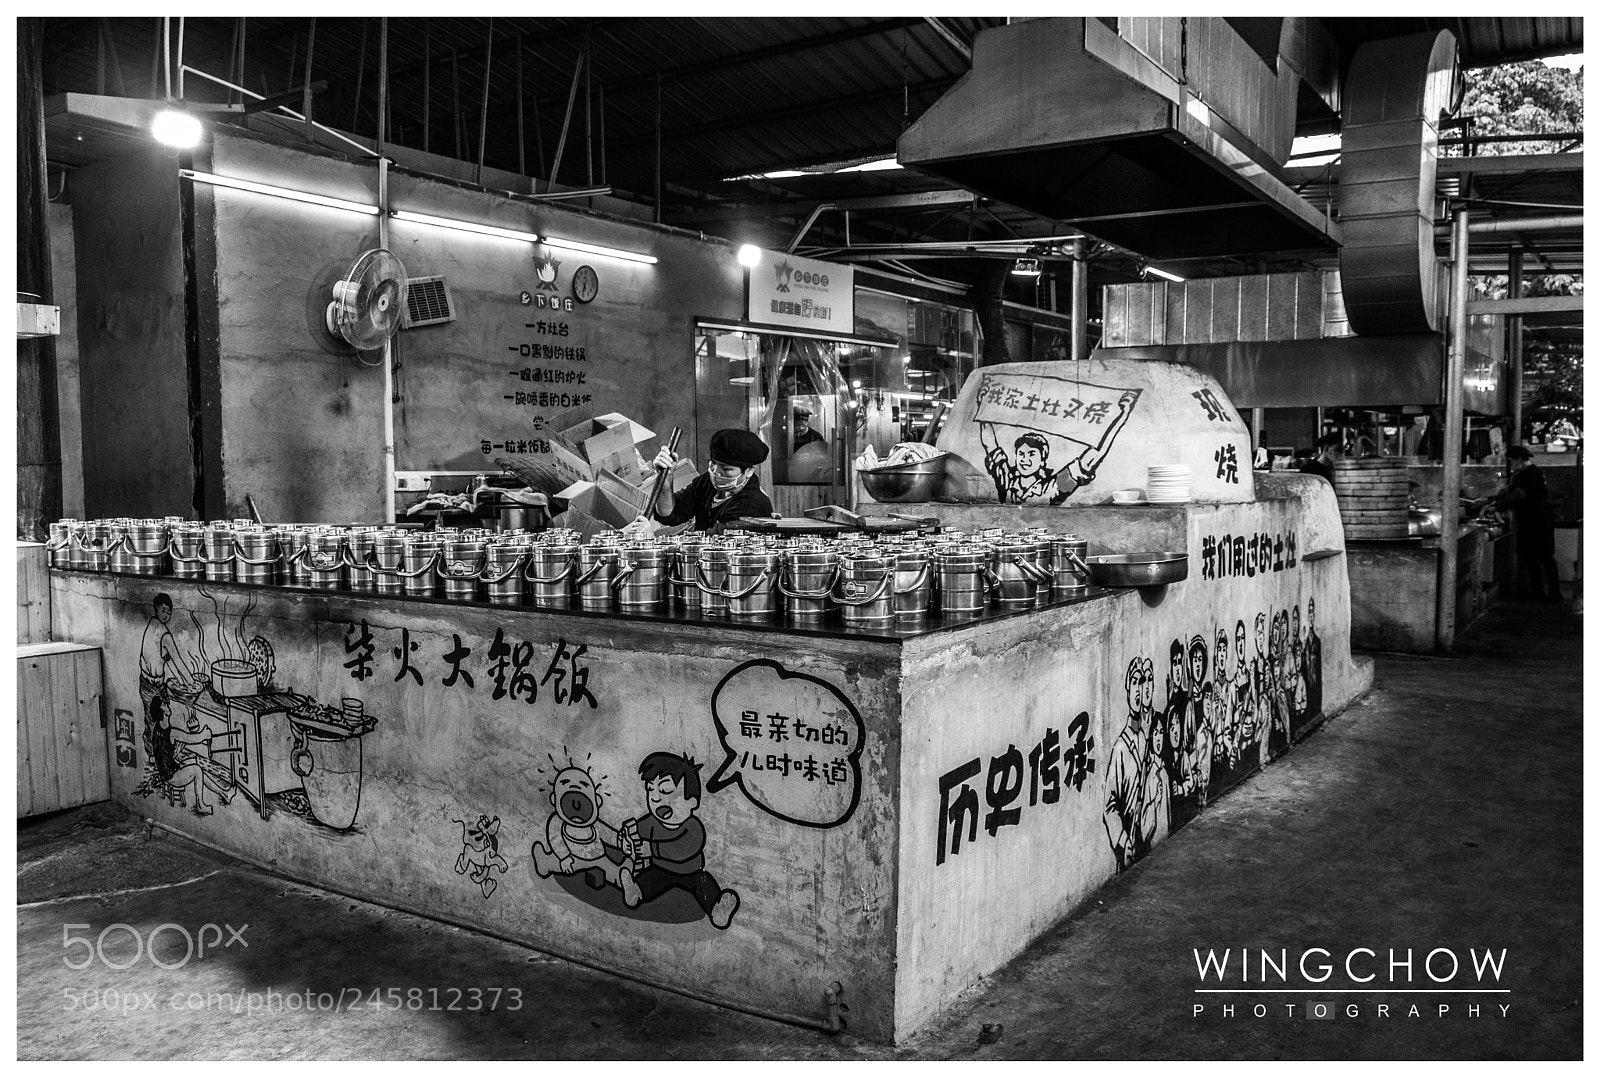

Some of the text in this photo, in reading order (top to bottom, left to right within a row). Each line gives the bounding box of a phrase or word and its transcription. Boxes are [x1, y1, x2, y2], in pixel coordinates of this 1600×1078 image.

[521, 292, 573, 311] 乡下饭庄
[525, 319, 569, 337] 一方灶台
[986, 383, 1112, 425] 我家土灶叉烧
[480, 439, 553, 455] 每一粒米饭都
[1202, 530, 1297, 581] 我们用过的土灶
[342, 618, 598, 709] 柴火大锅饭
[739, 710, 849, 746] 最亲切的
[738, 751, 849, 786] 儿时味道
[936, 711, 1096, 866] 历史传承
